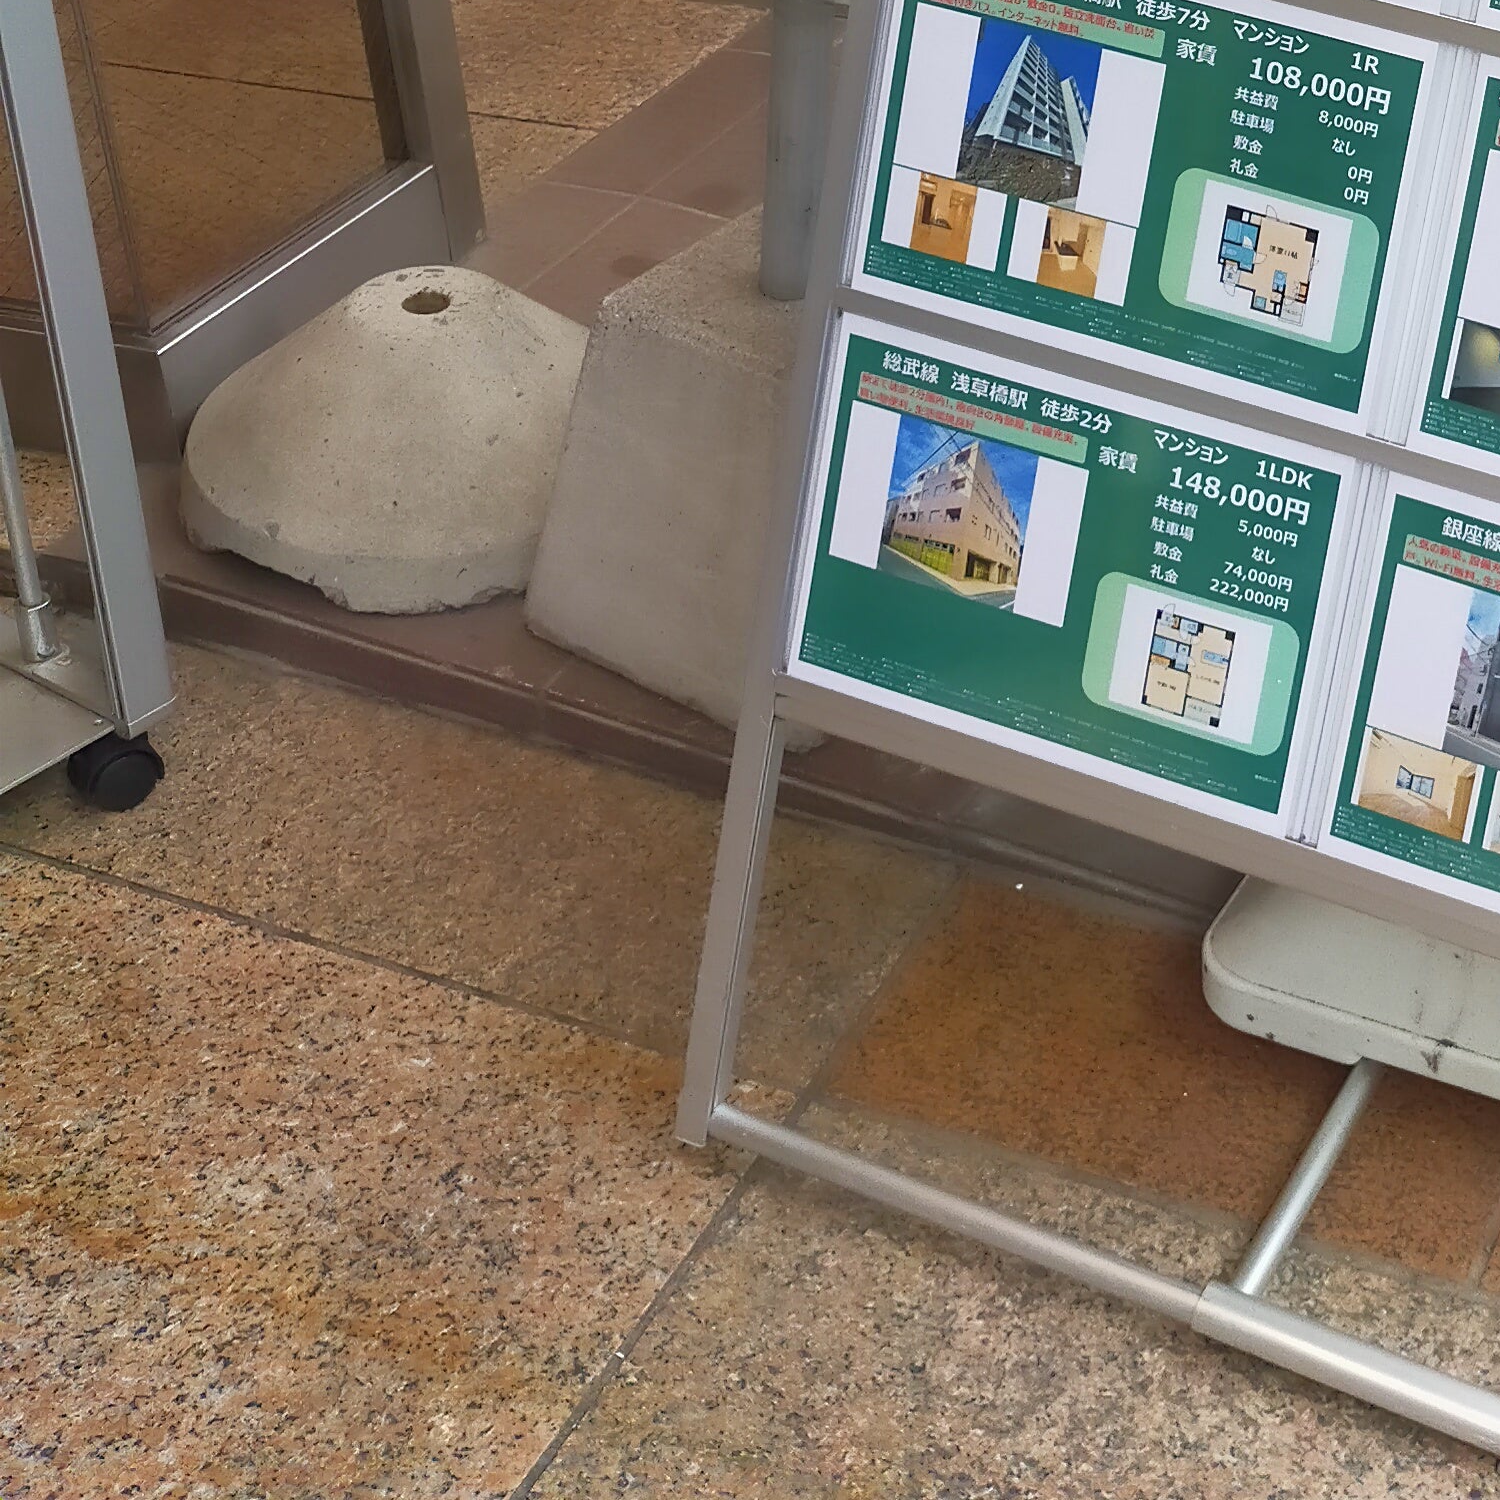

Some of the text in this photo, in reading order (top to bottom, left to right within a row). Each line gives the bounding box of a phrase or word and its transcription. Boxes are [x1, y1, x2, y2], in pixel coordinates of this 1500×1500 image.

[1232, 18, 1310, 54] マンション
[1350, 50, 1379, 75] 1R
[1174, 37, 1391, 115] 家賃 108,000円
[1233, 85, 1379, 138] 共益費 8,000円
[1228, 157, 1369, 205] 礼金 0円
[881, 349, 940, 384] 総武線
[949, 370, 1029, 410] 浅草橋駅
[1039, 396, 1113, 434] 徒歩2分
[1153, 428, 1229, 465] マンション
[1254, 459, 1313, 491] 1LDK
[1097, 444, 1310, 526] 家賃 148,000円
[1153, 493, 1298, 548] 共益費 5,000円
[1149, 562, 1289, 612] 礼金 222,000円
[1152, 540, 1293, 592] 敷金 74,000円
